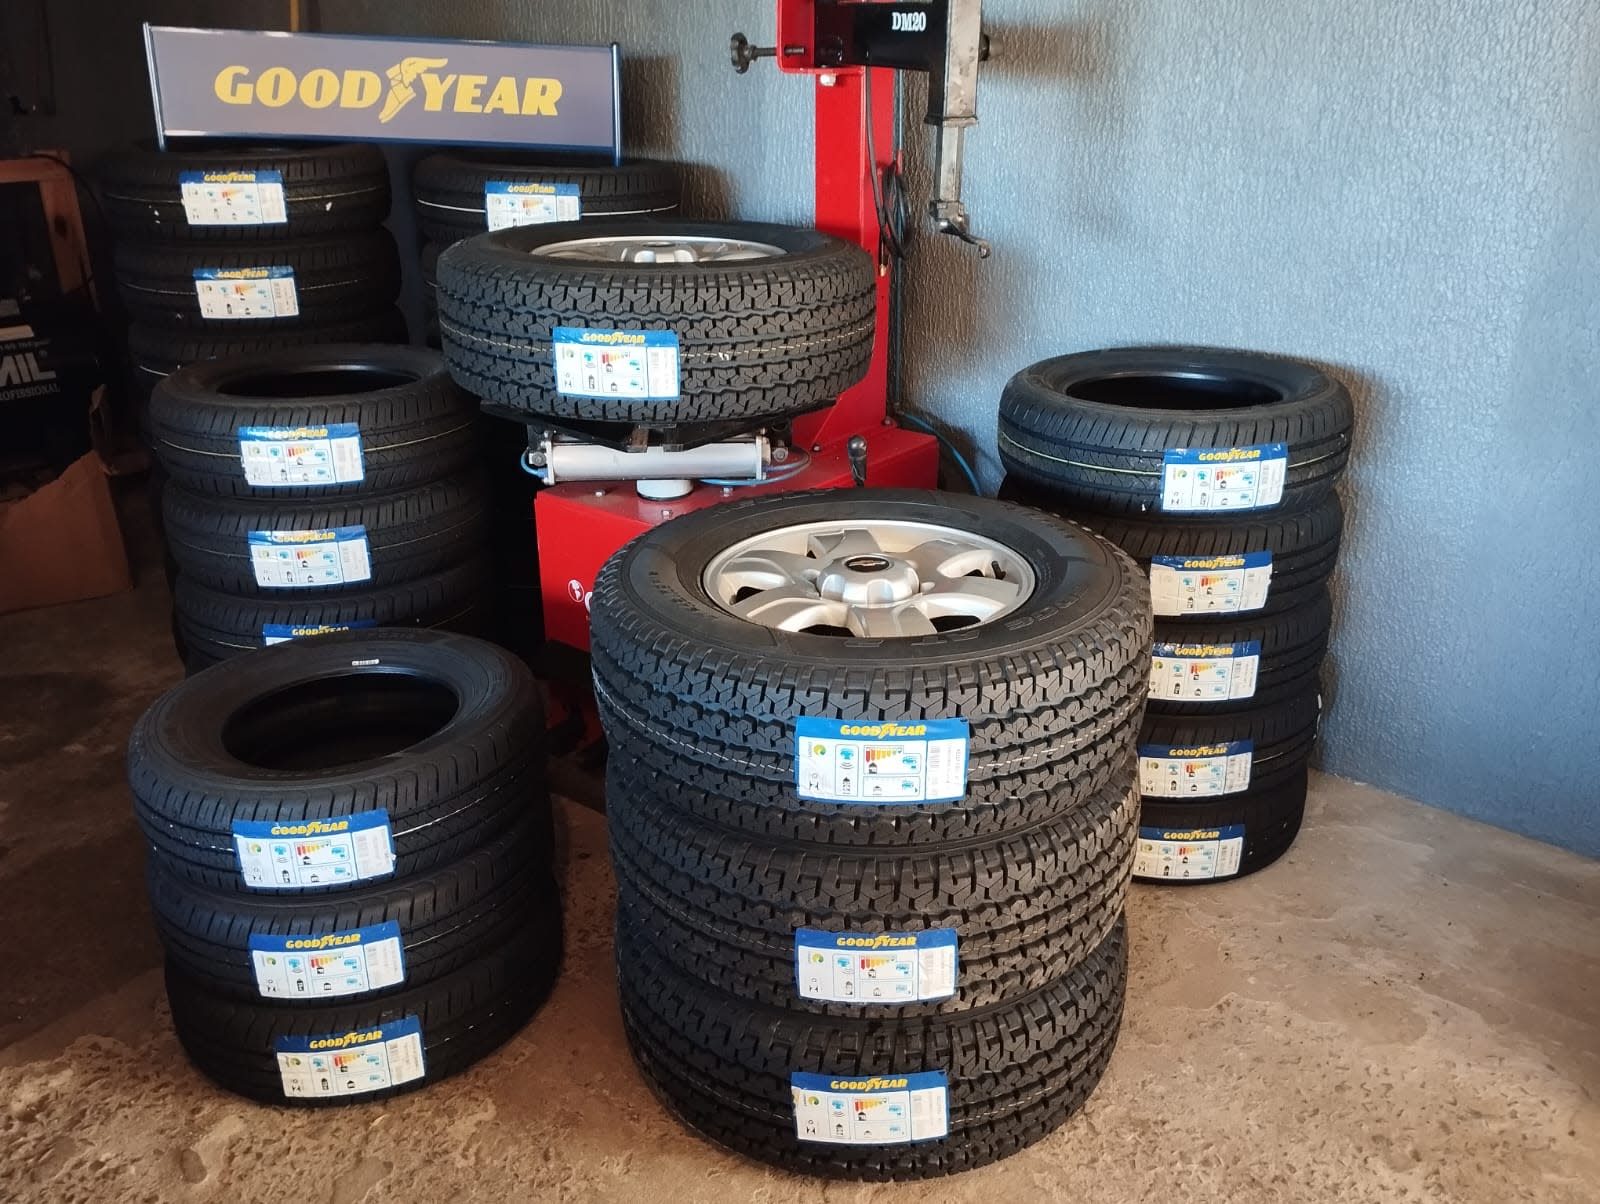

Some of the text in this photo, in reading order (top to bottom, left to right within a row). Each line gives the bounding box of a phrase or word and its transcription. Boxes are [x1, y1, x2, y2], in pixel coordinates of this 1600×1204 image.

[892, 11, 927, 32] DM20
[214, 62, 562, 119] GOODYEAR
[204, 172, 256, 182] GOODYEAR
[507, 184, 556, 194] GOODYEAR
[217, 269, 269, 279] GOODYEAR
[583, 333, 646, 344] GOODYEAR
[270, 428, 329, 439] GOODYEAR
[1198, 449, 1261, 461] GOODYEAR
[276, 532, 336, 543] GOODYEAR
[1183, 557, 1246, 569] GOODYEAR
[1174, 646, 1233, 657] GOODYEAR
[840, 724, 927, 738] GOODYEAR
[1169, 747, 1227, 757] GOODYEAR
[271, 821, 349, 836] GOODYEAR
[1163, 831, 1220, 841] GOODYEAR
[286, 933, 361, 949] GOODYEAR
[836, 936, 917, 948] GOODYEAR
[309, 1031, 382, 1049] GOODYEAR
[830, 1078, 908, 1092] GOODYEAR
